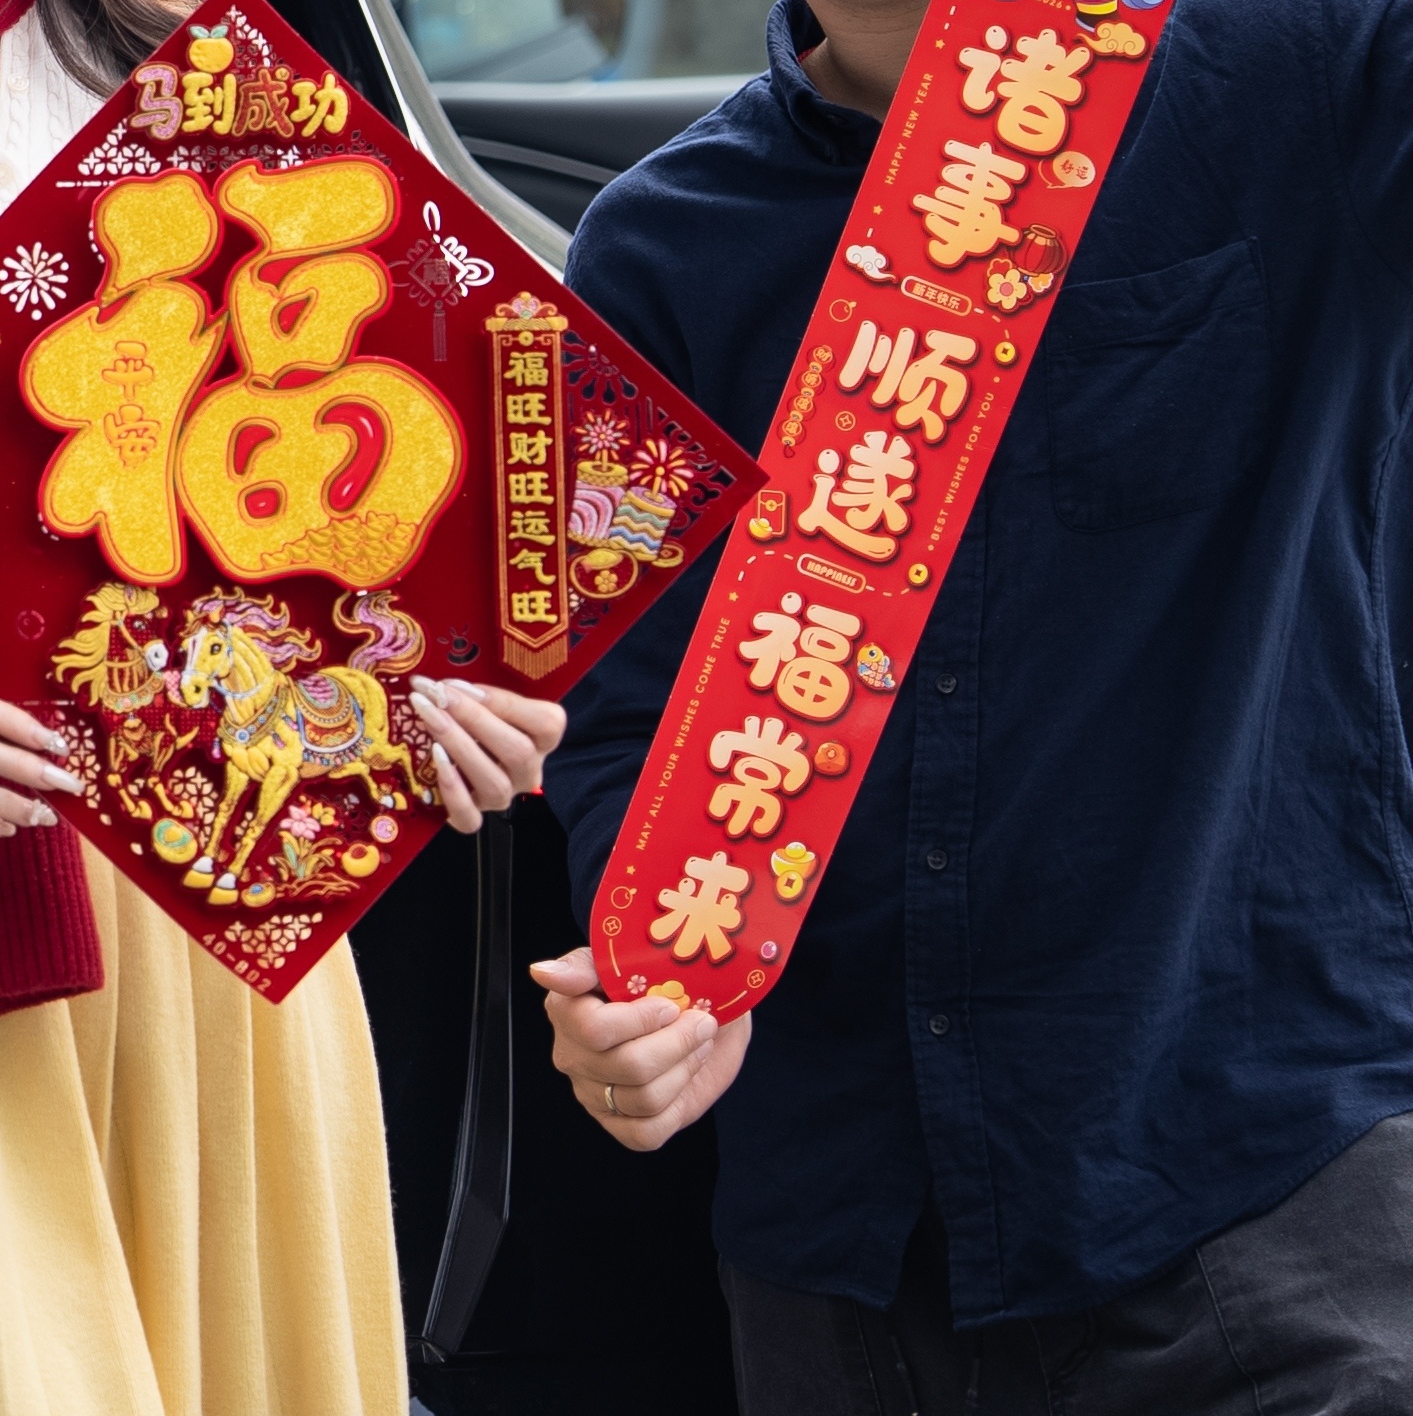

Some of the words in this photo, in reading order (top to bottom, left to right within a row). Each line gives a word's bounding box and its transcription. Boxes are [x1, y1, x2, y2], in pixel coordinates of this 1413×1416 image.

[129, 64, 350, 142] 马到成功
[884, 143, 907, 185] HAPPY
[902, 109, 919, 138] NEW
[914, 73, 933, 105] YEAR
[912, 281, 962, 310] 新年快乐
[19, 157, 469, 587] 福
[101, 341, 162, 469] 平安
[503, 350, 558, 626] 福旺财旺运气旺
[930, 509, 949, 541] BEST
[944, 455, 970, 504] WISHES
[965, 425, 982, 451] FOR
[977, 392, 995, 419] YOU
[635, 821, 653, 851] MAY
[648, 793, 665, 818] ALL
[658, 752, 680, 789] YOUR
[673, 698, 700, 748] WISHES
[694, 654, 717, 694] COME
[711, 616, 731, 650] TRUE
[202, 933, 272, 993] 40-802
